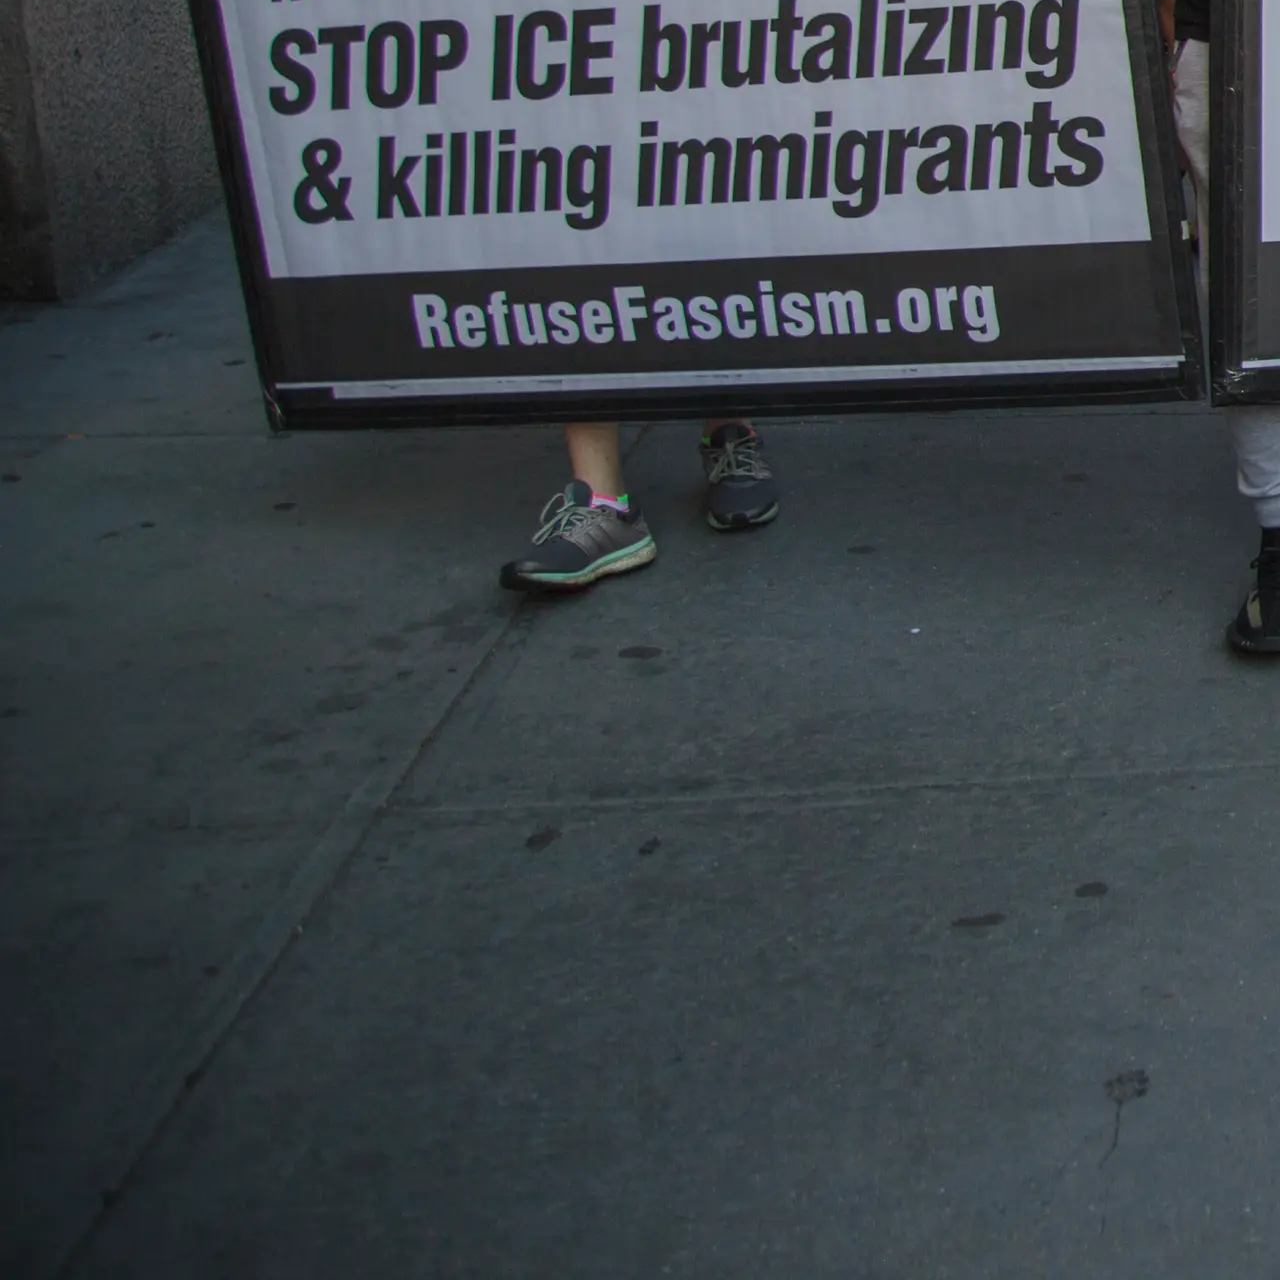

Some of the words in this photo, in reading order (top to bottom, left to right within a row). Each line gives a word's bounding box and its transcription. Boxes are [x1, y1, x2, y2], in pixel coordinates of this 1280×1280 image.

[267, 18, 470, 116] STOP
[491, 7, 616, 101] ICE
[292, 138, 354, 225] &
[376, 129, 612, 231] killing
[636, 101, 1107, 219] immigrants
[412, 280, 1001, 350] RefuseFascism.org
